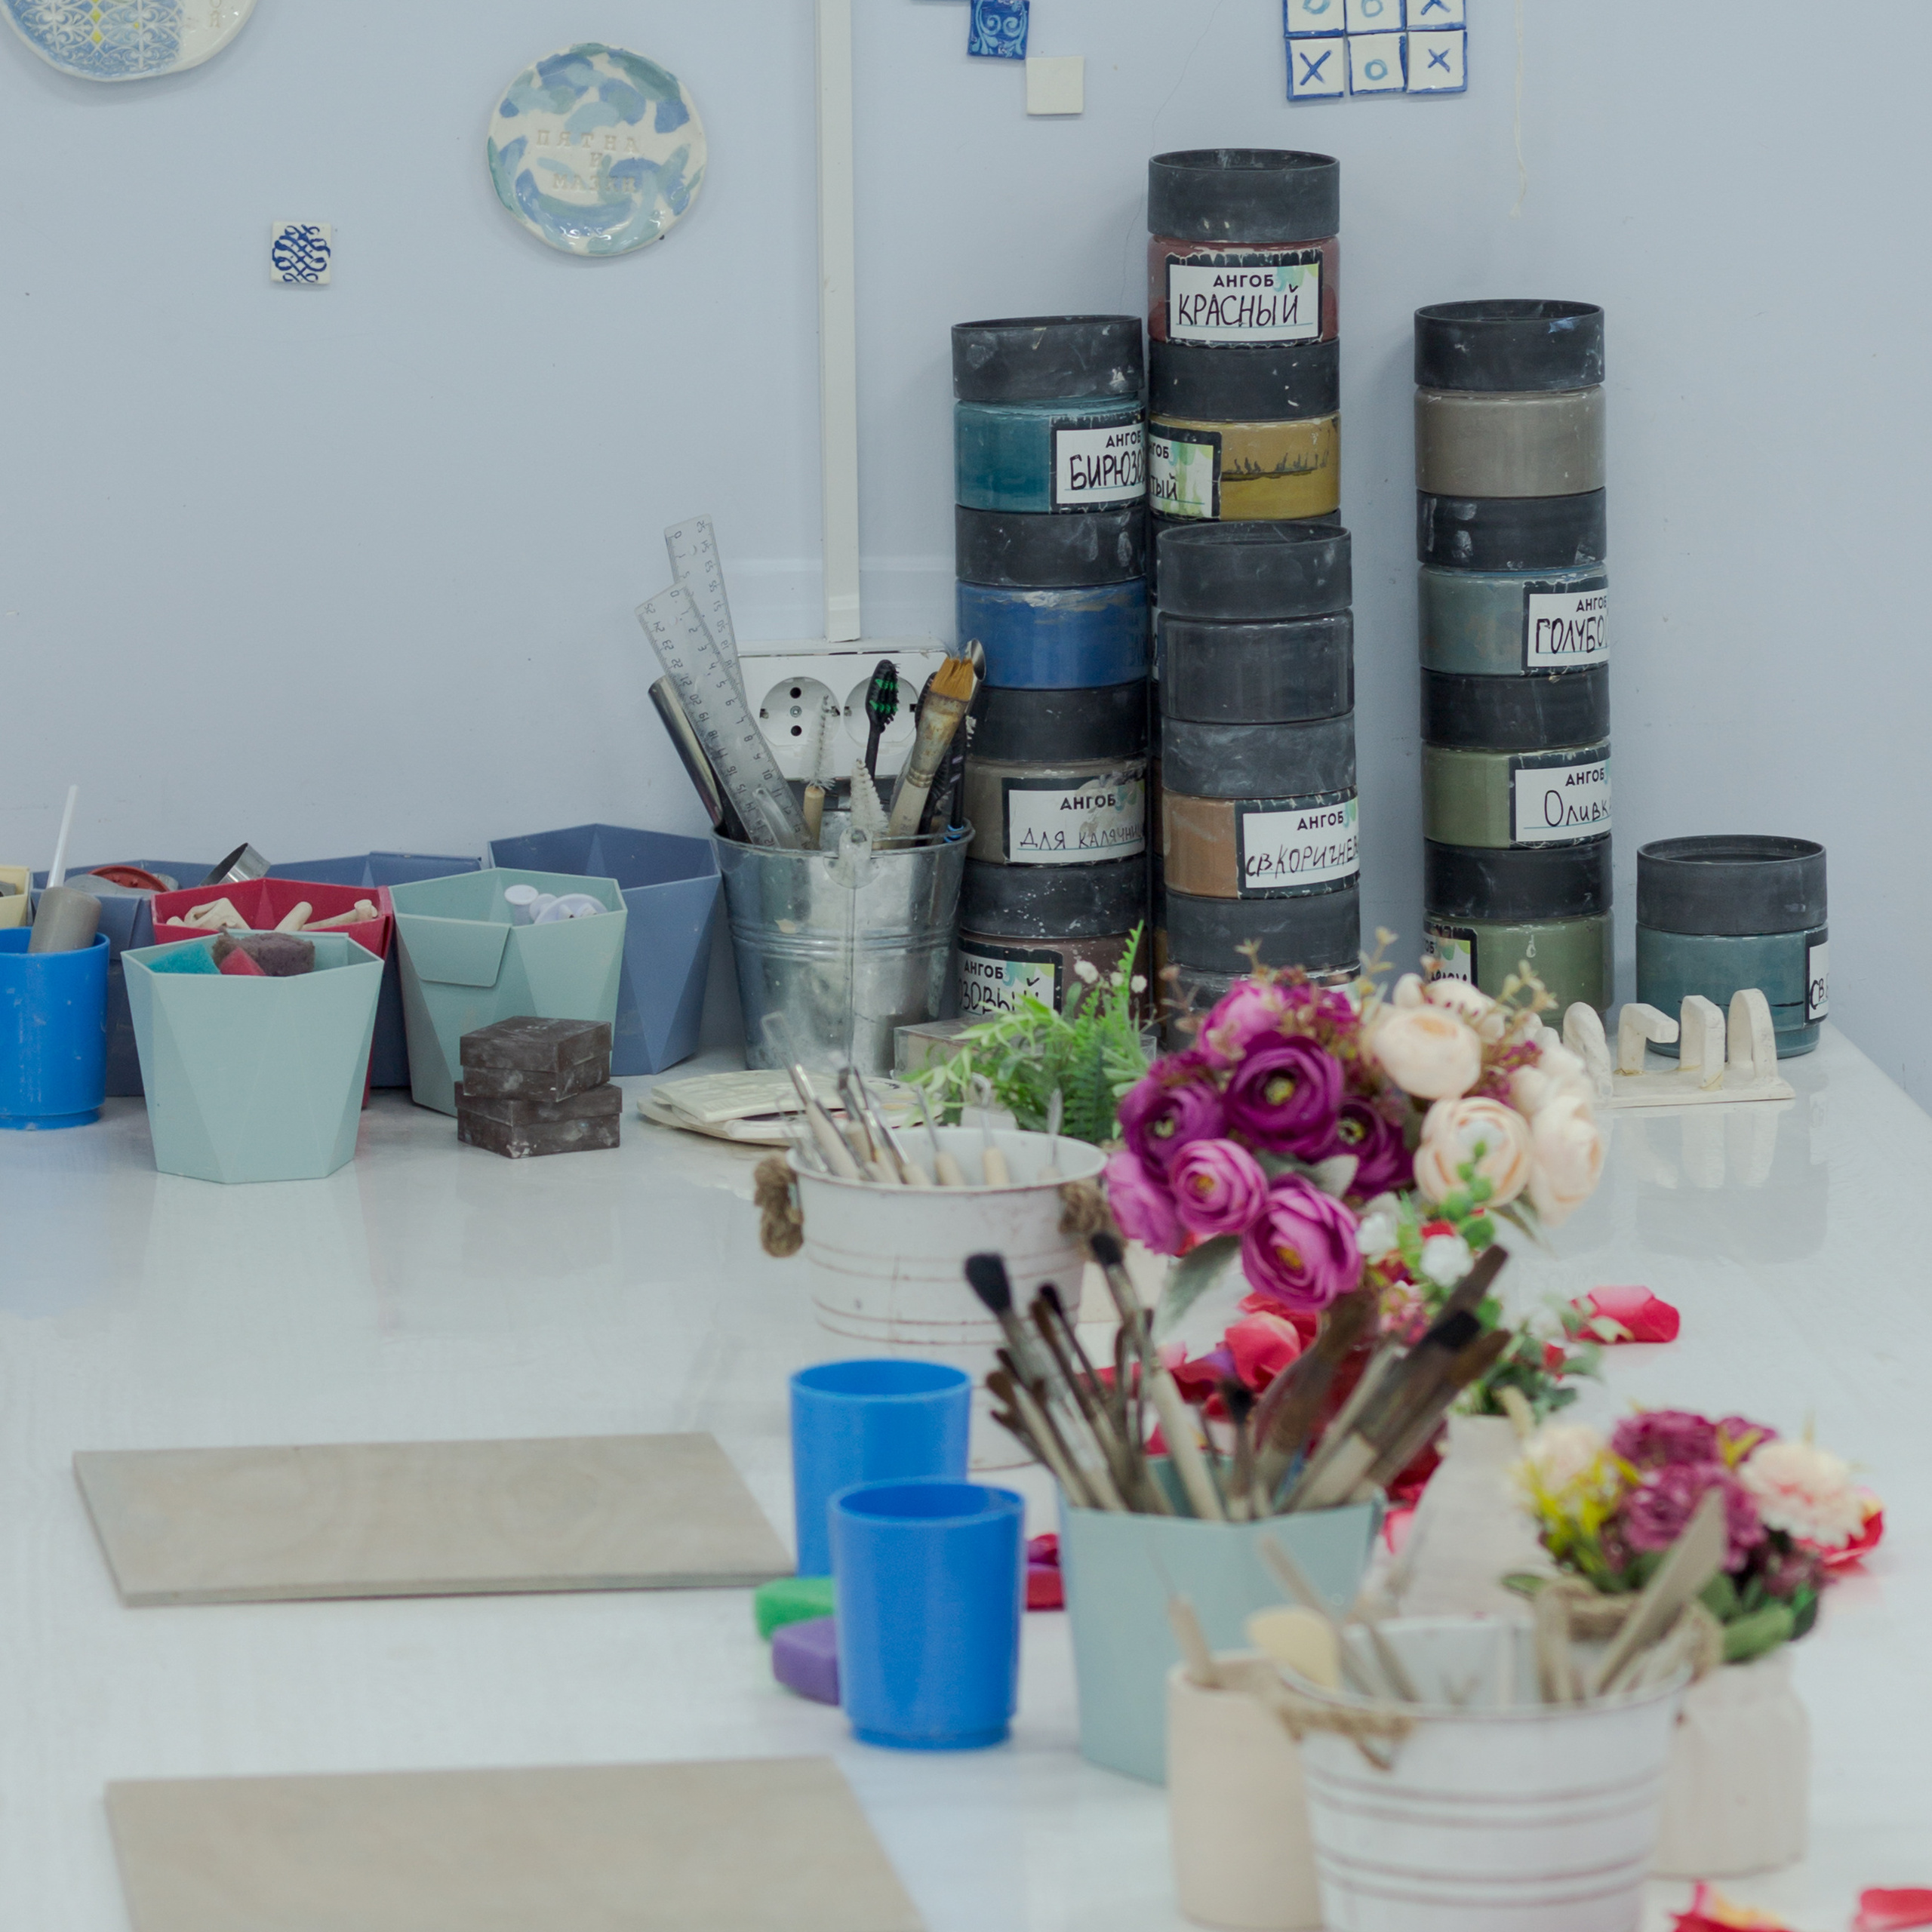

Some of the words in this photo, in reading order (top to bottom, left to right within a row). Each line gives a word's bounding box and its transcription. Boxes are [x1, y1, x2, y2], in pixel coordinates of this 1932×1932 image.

[537, 130, 639, 153] ПЯТНА
[1213, 275, 1274, 288] АНГОБ
[1179, 284, 1299, 327] КРАСНЫЙ
[1070, 448, 1145, 491] БИРЮЗО
[1536, 615, 1607, 654] ГОЛУБО
[1565, 768, 1604, 786] АНГОБ
[1060, 794, 1116, 811] АНГОБ
[1544, 789, 1612, 827] Оливк
[1297, 811, 1344, 830] АНГОБ
[1020, 828, 1066, 850] ДЛЯ
[964, 960, 1004, 980] АНГОБ
